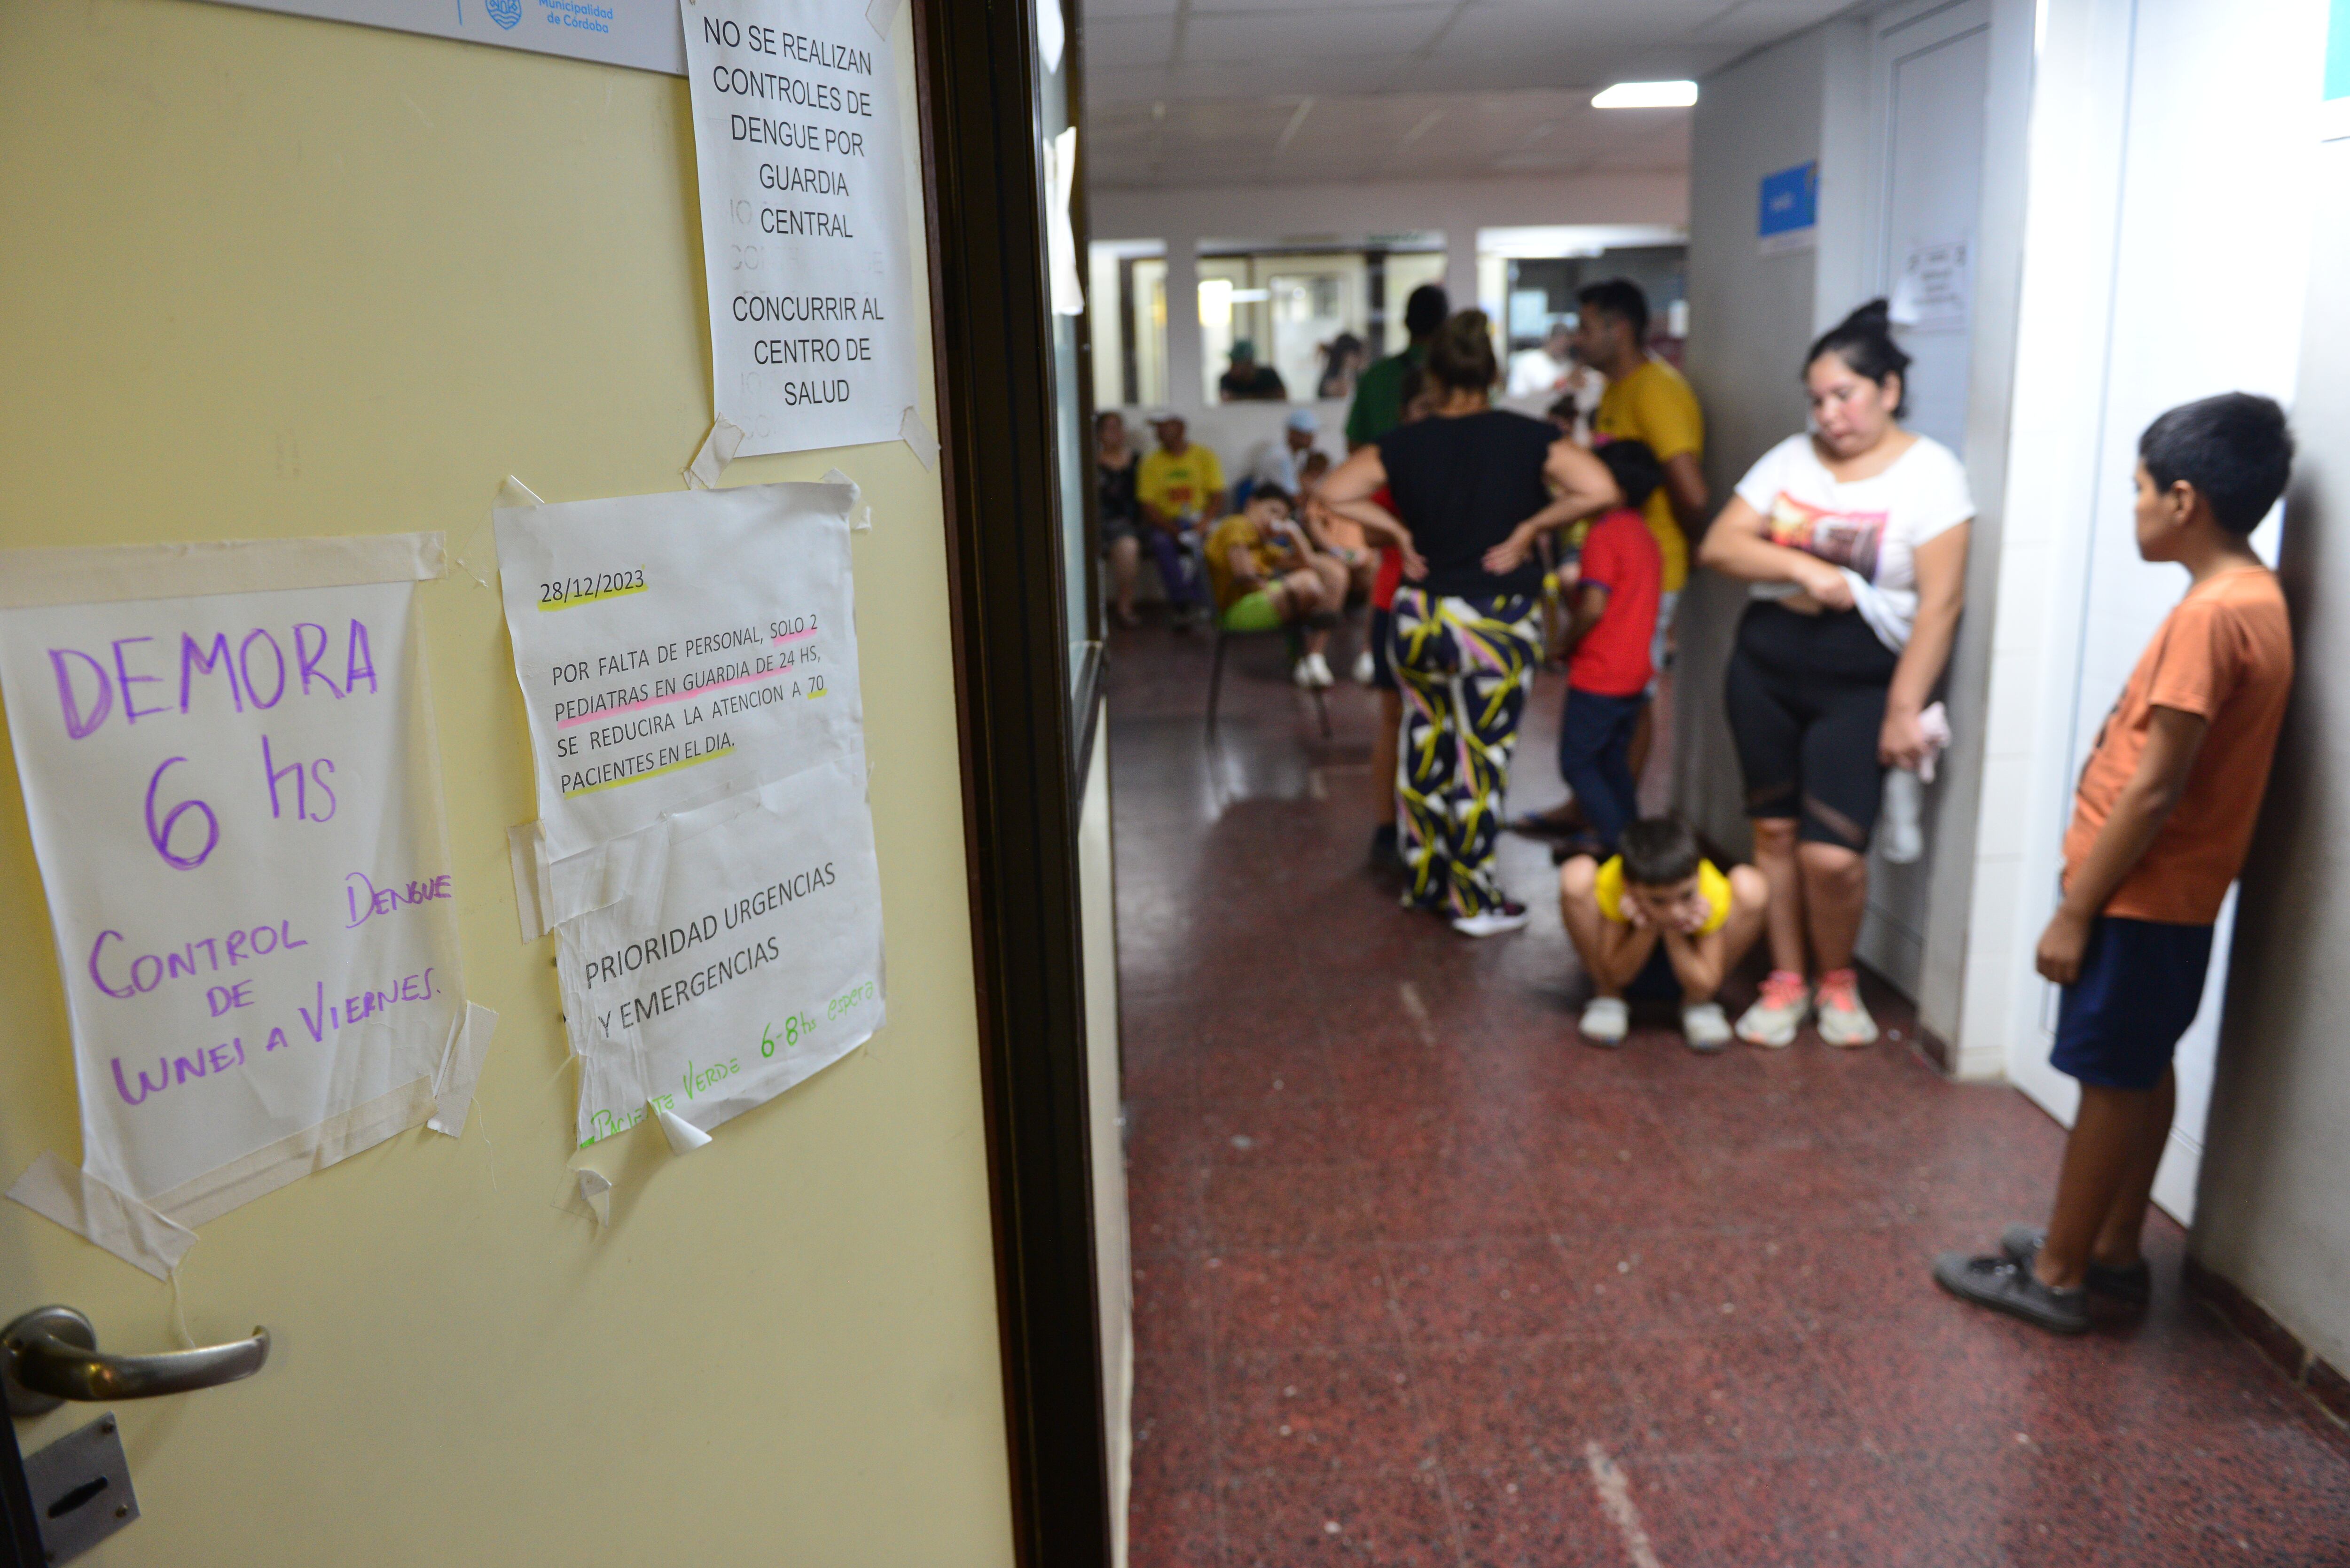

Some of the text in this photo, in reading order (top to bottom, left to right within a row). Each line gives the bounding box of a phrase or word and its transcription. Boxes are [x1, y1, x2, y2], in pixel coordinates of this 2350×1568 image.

[547, 12, 609, 33] de Córdoba
[704, 16, 871, 76] NO SE REALIZAN
[713, 66, 871, 117] CONTROLES DE
[732, 115, 863, 157] DENGUE POR
[760, 164, 849, 196] GUARDIA
[761, 208, 853, 238] CENTRAL
[733, 296, 884, 321] CONCURRIR AL
[754, 338, 870, 365] CENTRO DE
[784, 380, 849, 406] SALUD
[540, 569, 644, 603] 28/12/2023
[552, 614, 817, 686] POR FALTA DE PERSONAL, SOLO 2
[47, 618, 377, 740] DEMORA
[555, 684, 648, 722] PEDIATRAS
[655, 678, 675, 698] EN
[683, 662, 750, 692] GUARDIA
[756, 655, 773, 675] DE
[780, 650, 795, 669] 24
[557, 675, 824, 758] SE REDUCIRA LA ATENCION A 70
[561, 732, 735, 793] PACIENTES EN EL DIA.
[145, 734, 336, 871] 6 hs
[88, 872, 452, 999] CONTROL DENGUE
[585, 862, 835, 989] PRIORIDAD URGENCIAS
[207, 979, 255, 1017] DE
[598, 936, 779, 1038] Y EMERGENCIAS
[266, 1027, 288, 1051] A
[683, 1059, 741, 1100] VERDE
[827, 981, 874, 1021] espera
